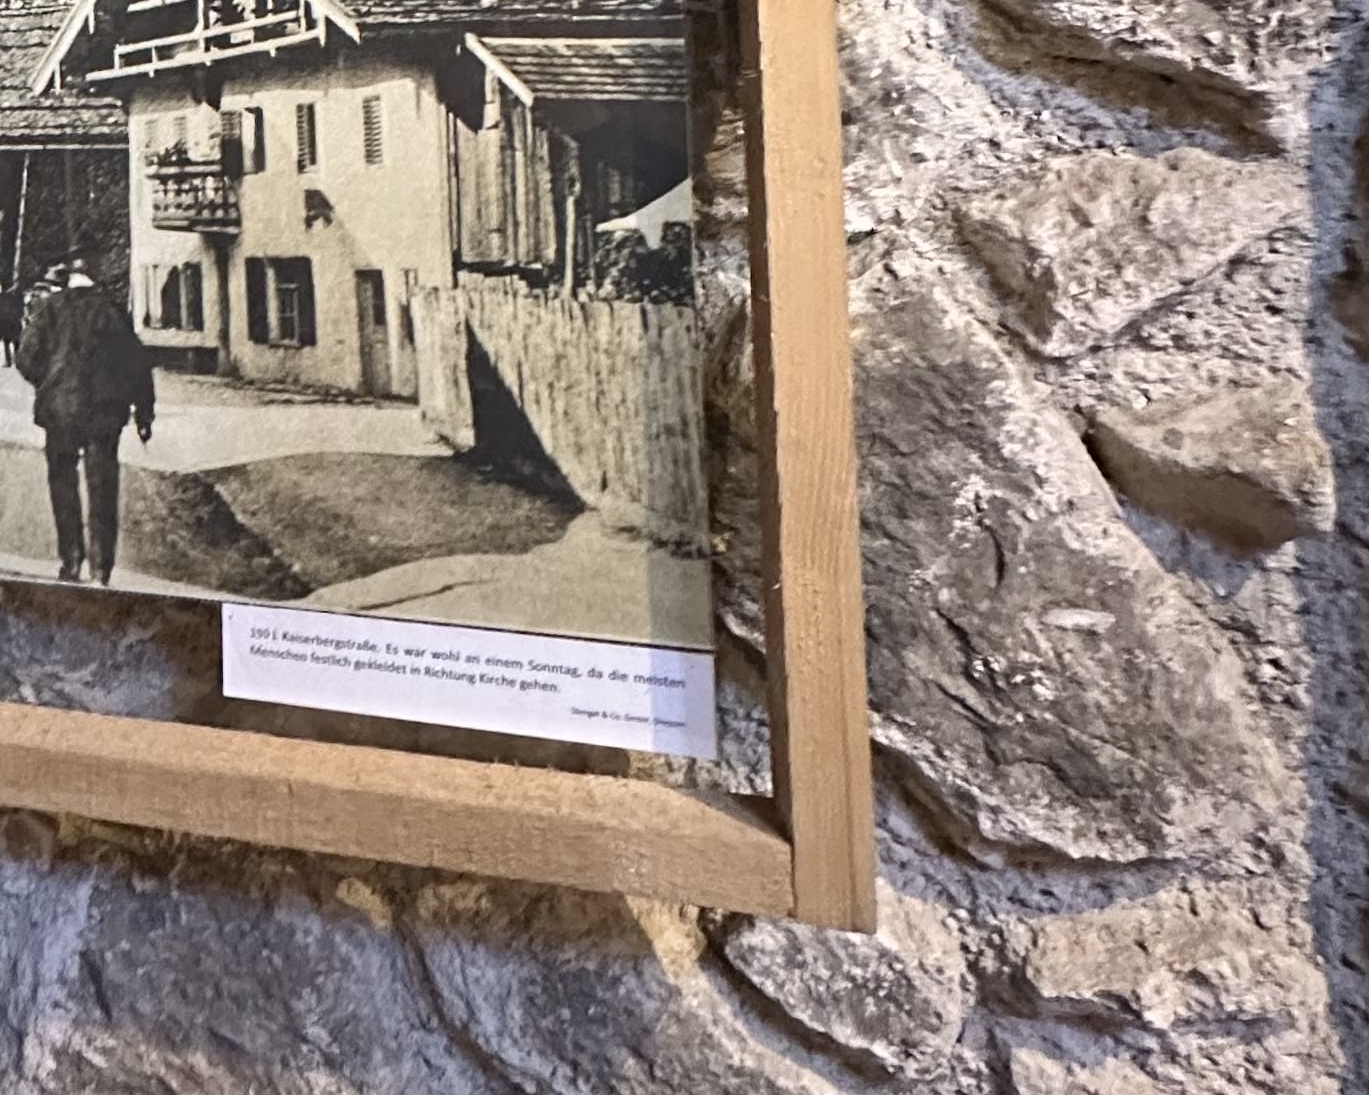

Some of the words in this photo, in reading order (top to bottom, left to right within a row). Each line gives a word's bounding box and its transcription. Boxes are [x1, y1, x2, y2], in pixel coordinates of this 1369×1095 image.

[249, 644, 308, 662] Menschen
[310, 651, 351, 667] festlich
[353, 658, 407, 675] gekleidet
[410, 665, 421, 675] in
[424, 666, 476, 686] Richtung
[479, 672, 517, 689] Kirche
[519, 678, 562, 694] gehen.
[385, 643, 399, 655] Es
[404, 648, 426, 658] war
[431, 650, 460, 662] wohl
[464, 655, 480, 665] an
[484, 656, 524, 670] einem
[527, 659, 582, 679] Sonntag,
[587, 667, 604, 680] da
[608, 670, 628, 683] die
[633, 674, 686, 689] meisten
